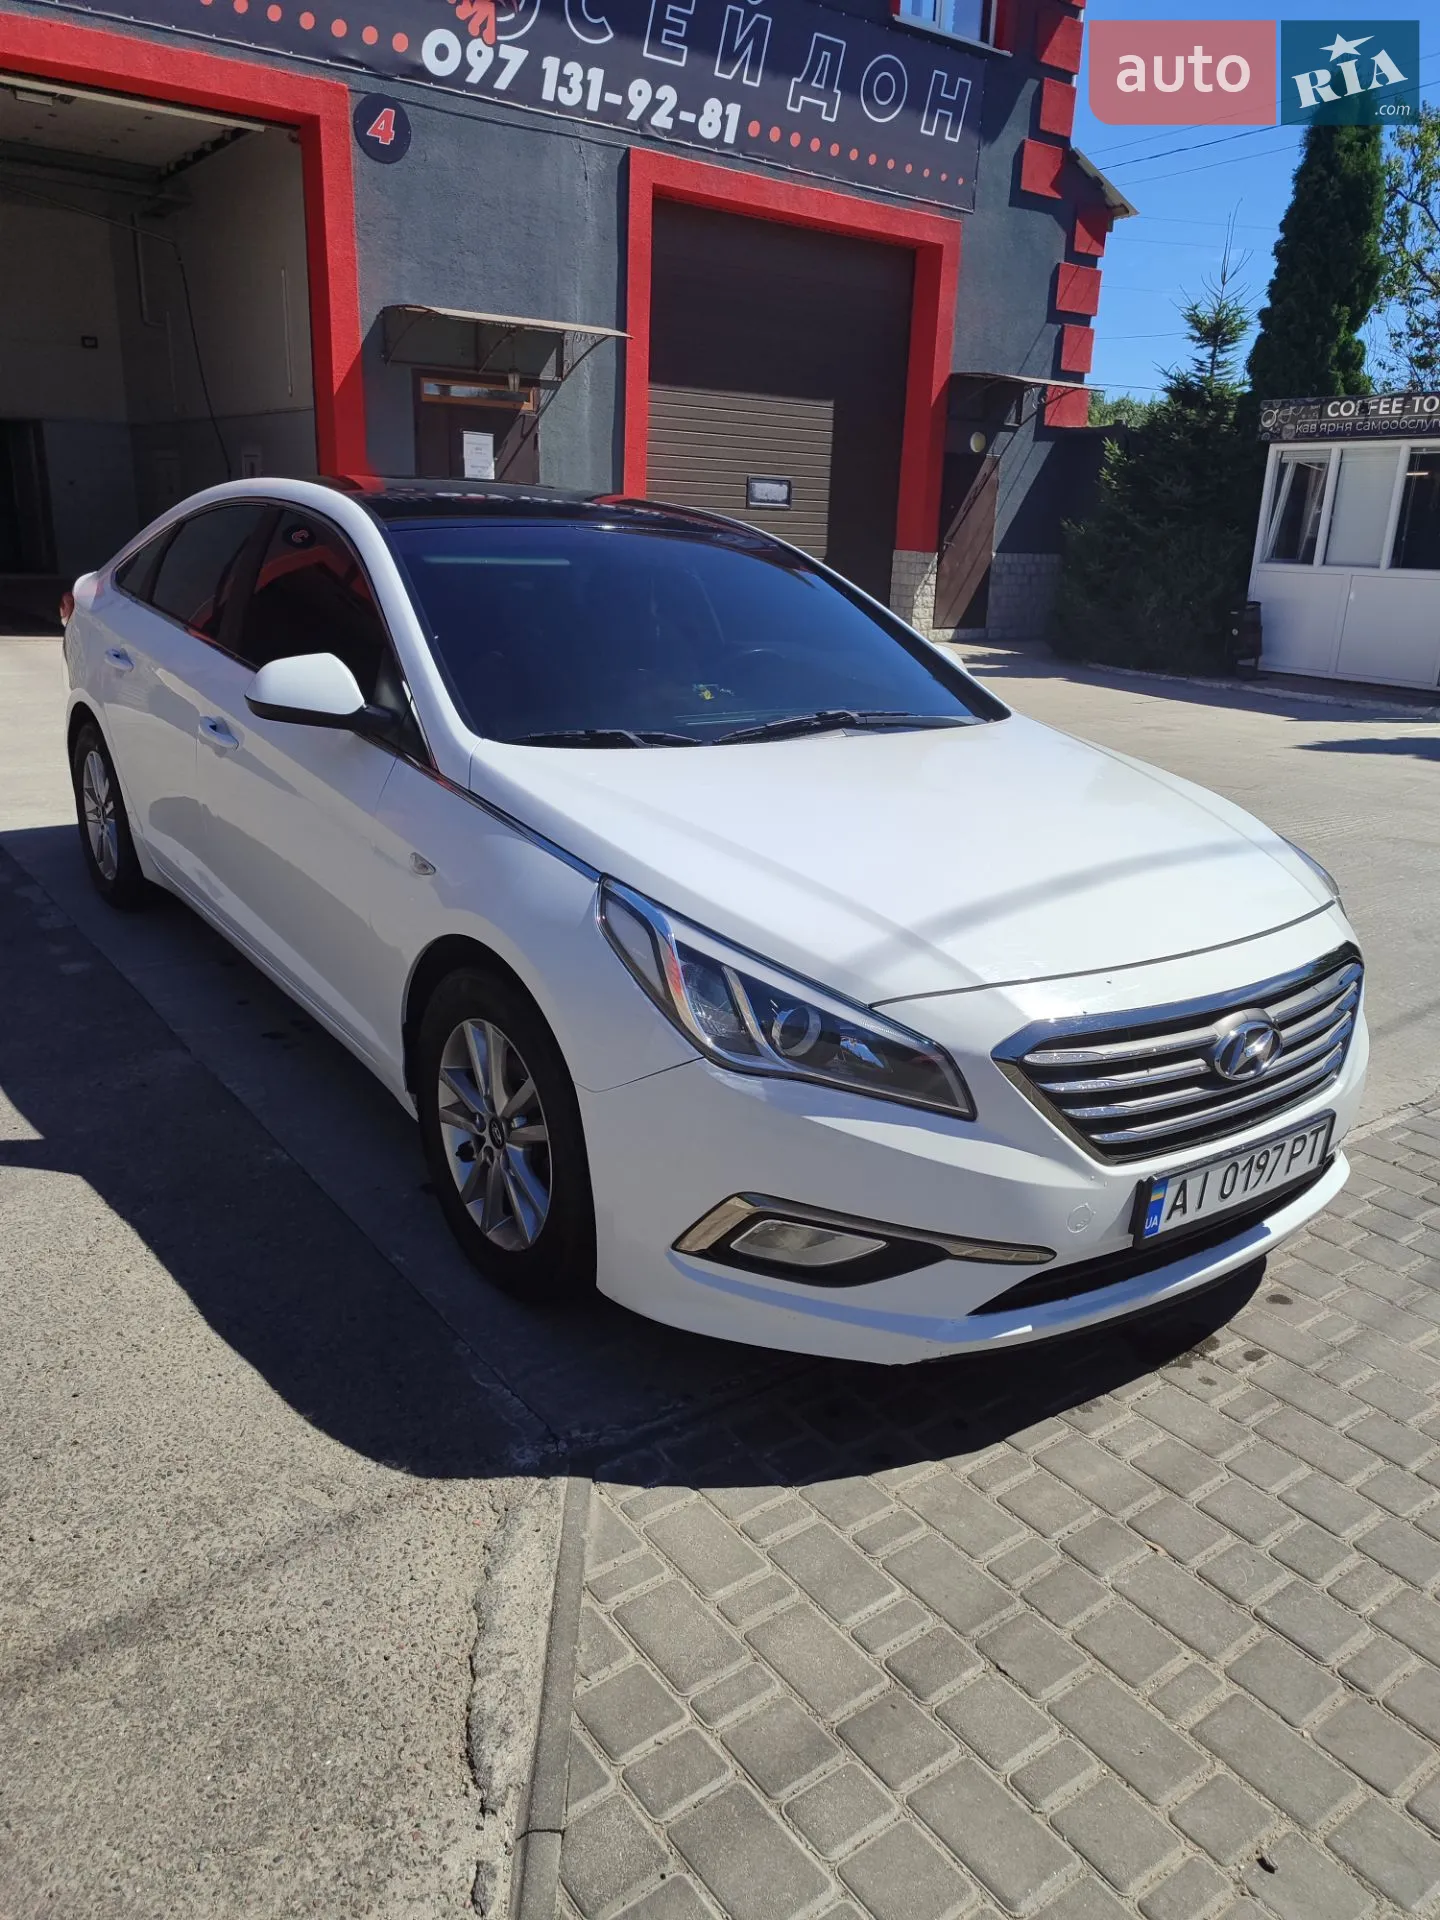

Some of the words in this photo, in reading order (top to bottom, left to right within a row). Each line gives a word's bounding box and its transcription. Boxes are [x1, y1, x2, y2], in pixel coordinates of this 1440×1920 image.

[422, 28, 529, 90] 097
[541, 56, 741, 144] 131-92-81
[366, 107, 395, 145] 4
[1355, 415, 1440, 432] самообслуг
[1219, 1142, 1286, 1201] 0197
[1285, 1124, 1327, 1176] PT
[1145, 1215, 1158, 1230] UA
